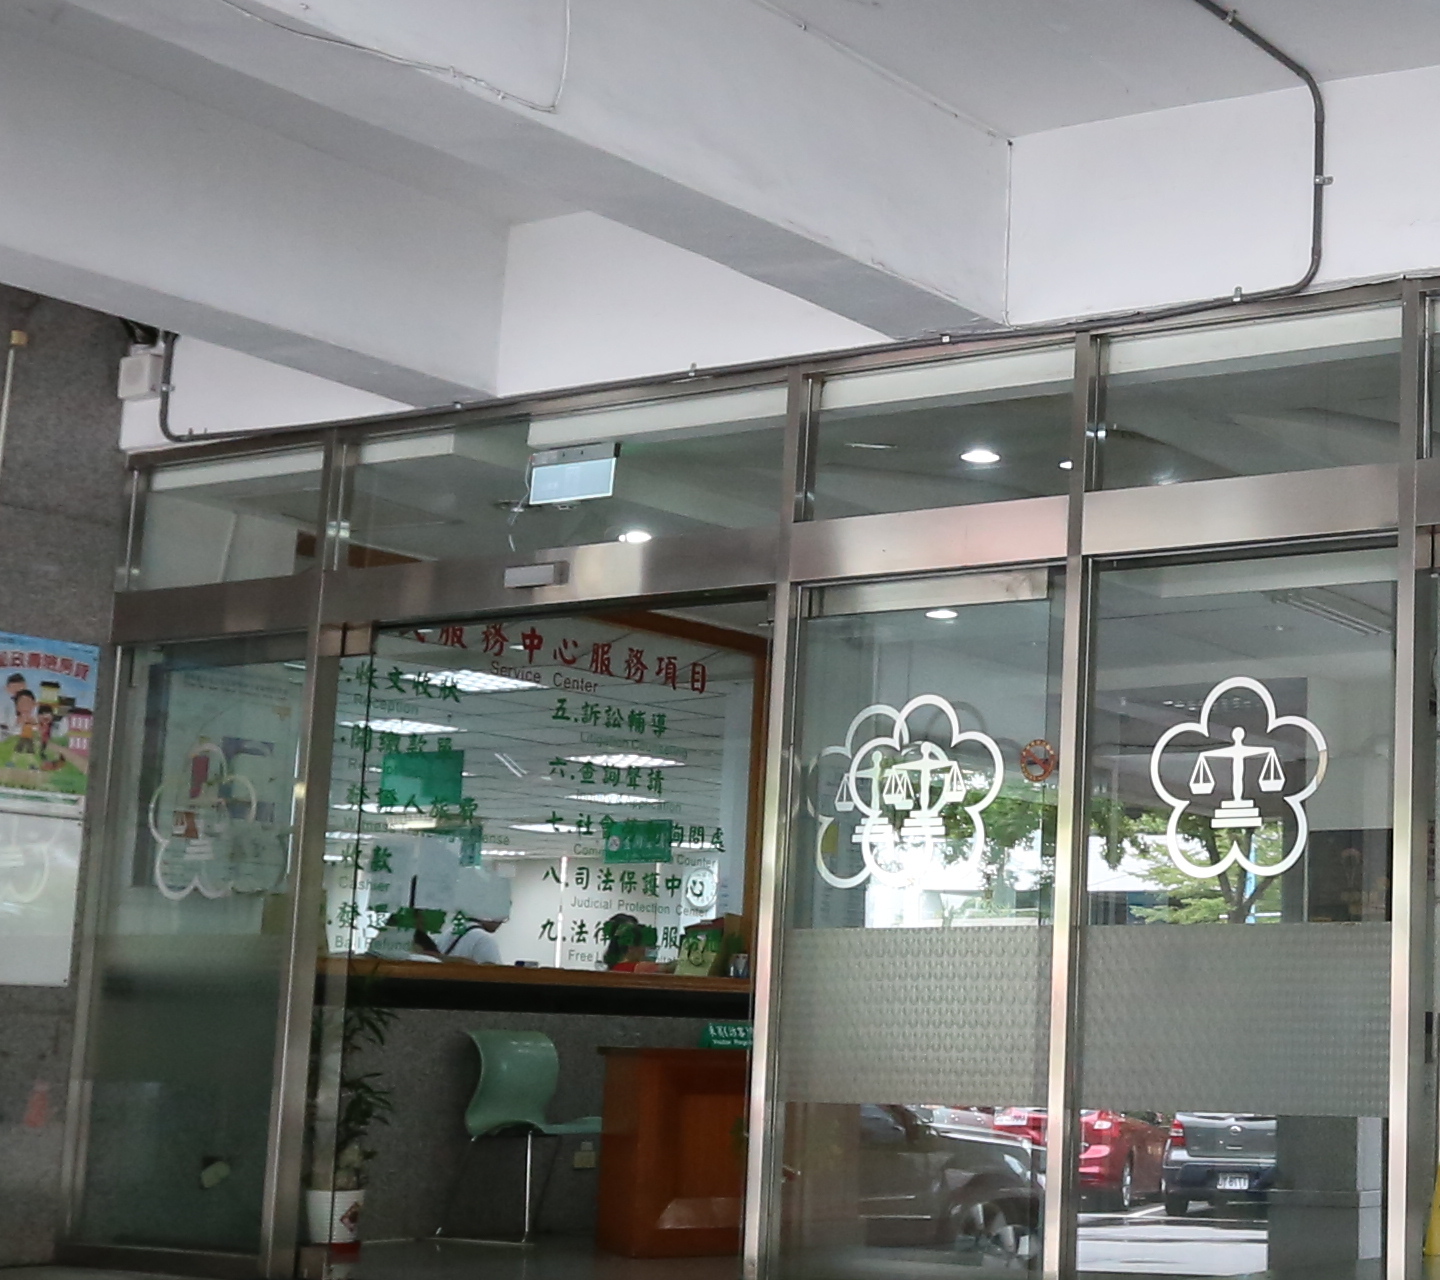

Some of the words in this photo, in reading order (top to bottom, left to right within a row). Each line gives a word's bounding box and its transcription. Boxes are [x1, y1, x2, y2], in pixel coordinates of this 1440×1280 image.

[400, 623, 707, 695] 服務中心服務項目
[340, 661, 460, 703] .收文收狀
[491, 660, 541, 683] Service
[553, 671, 599, 693] Center
[328, 843, 392, 874] .收款
[542, 865, 705, 899] 八.司法保護中心
[570, 896, 612, 911] Judicial
[617, 900, 671, 916] Protection
[675, 904, 709, 918] Center
